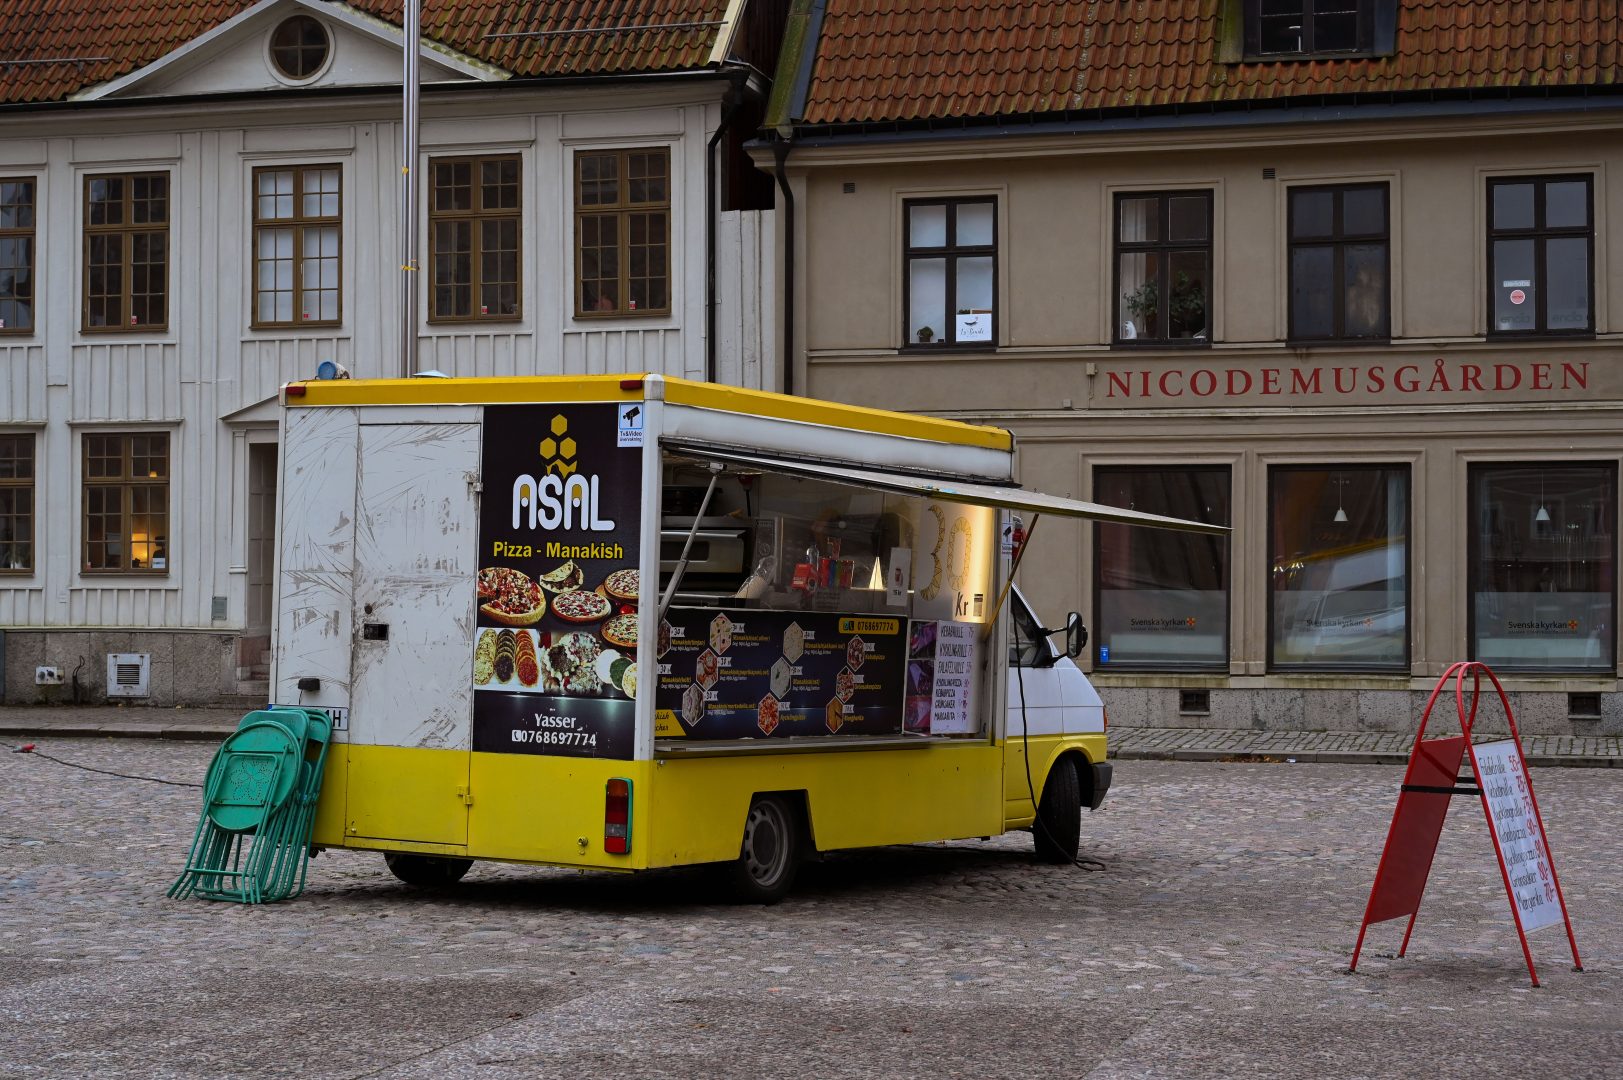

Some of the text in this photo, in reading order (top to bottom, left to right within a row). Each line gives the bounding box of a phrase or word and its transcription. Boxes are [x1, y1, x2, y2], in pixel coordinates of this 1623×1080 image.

[1106, 358, 1590, 398] NICODEMUSGÅRDEN
[512, 474, 616, 531] ASAL
[493, 541, 532, 557] Pizza
[546, 542, 623, 559] Manakish
[955, 591, 968, 618] Kr
[1130, 617, 1160, 627] Svenska
[1508, 619, 1568, 630] Svenska kyrkan
[534, 713, 577, 729] Yasser
[521, 729, 597, 747] 0768697774
